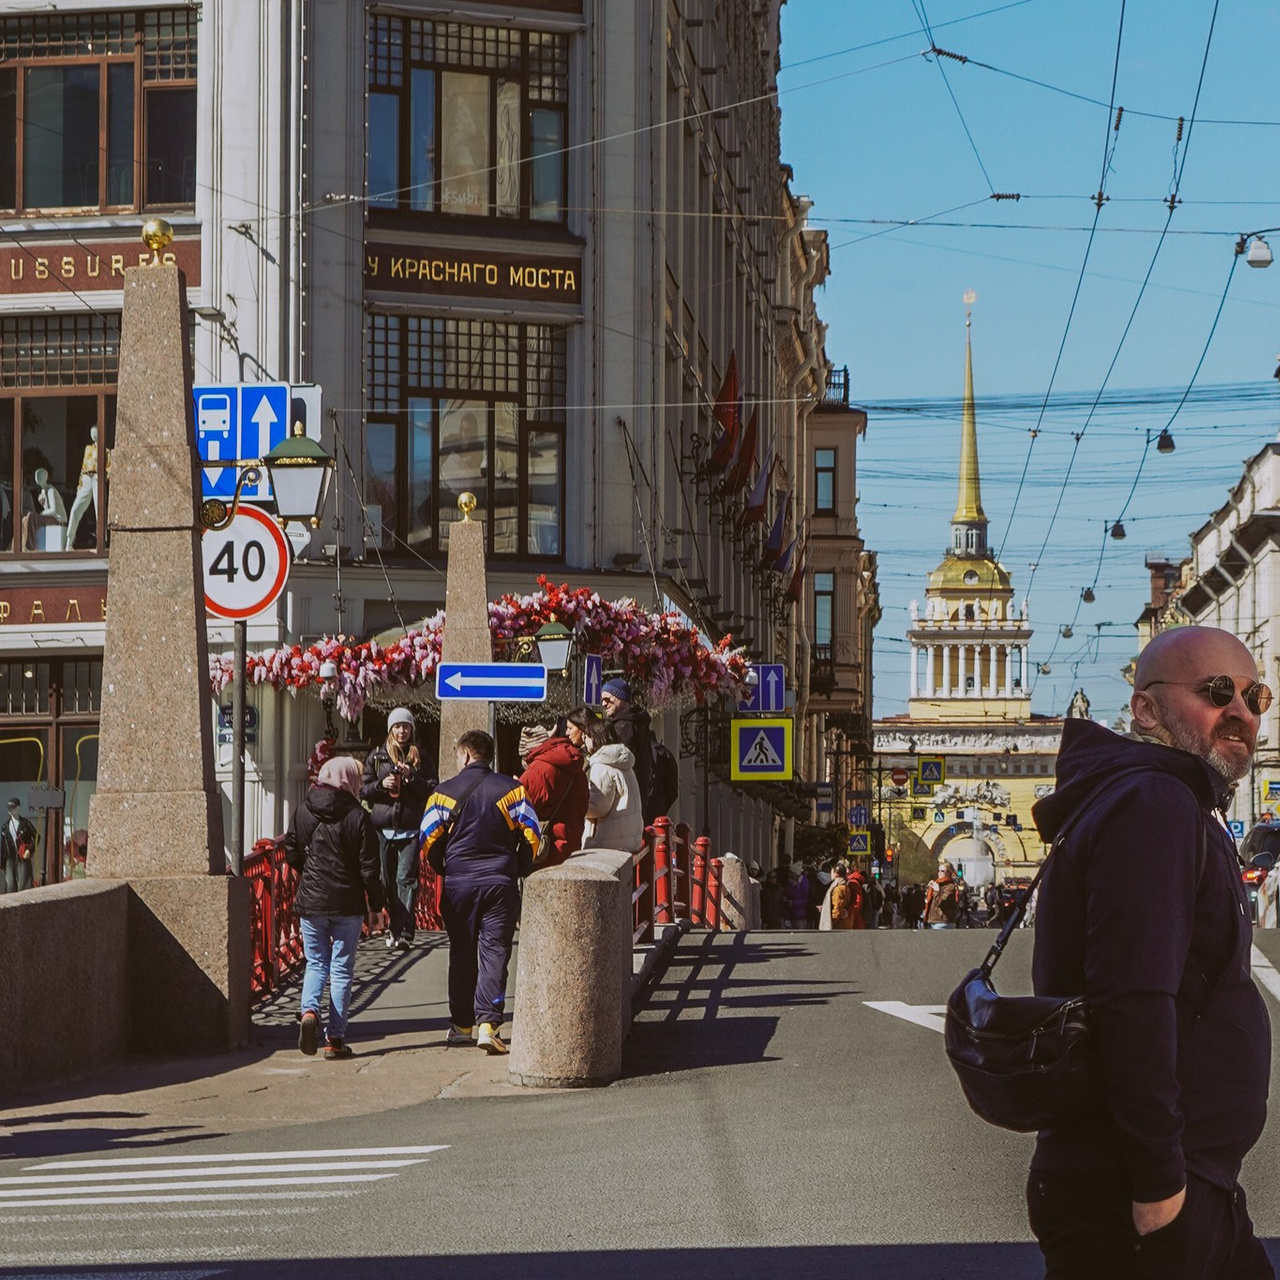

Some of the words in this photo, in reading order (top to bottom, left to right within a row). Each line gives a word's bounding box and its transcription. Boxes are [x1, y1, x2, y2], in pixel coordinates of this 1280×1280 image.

[367, 255, 379, 277] У
[390, 257, 498, 285] КРАСНАГО
[509, 265, 576, 291] МОСТА
[209, 540, 266, 583] 40
